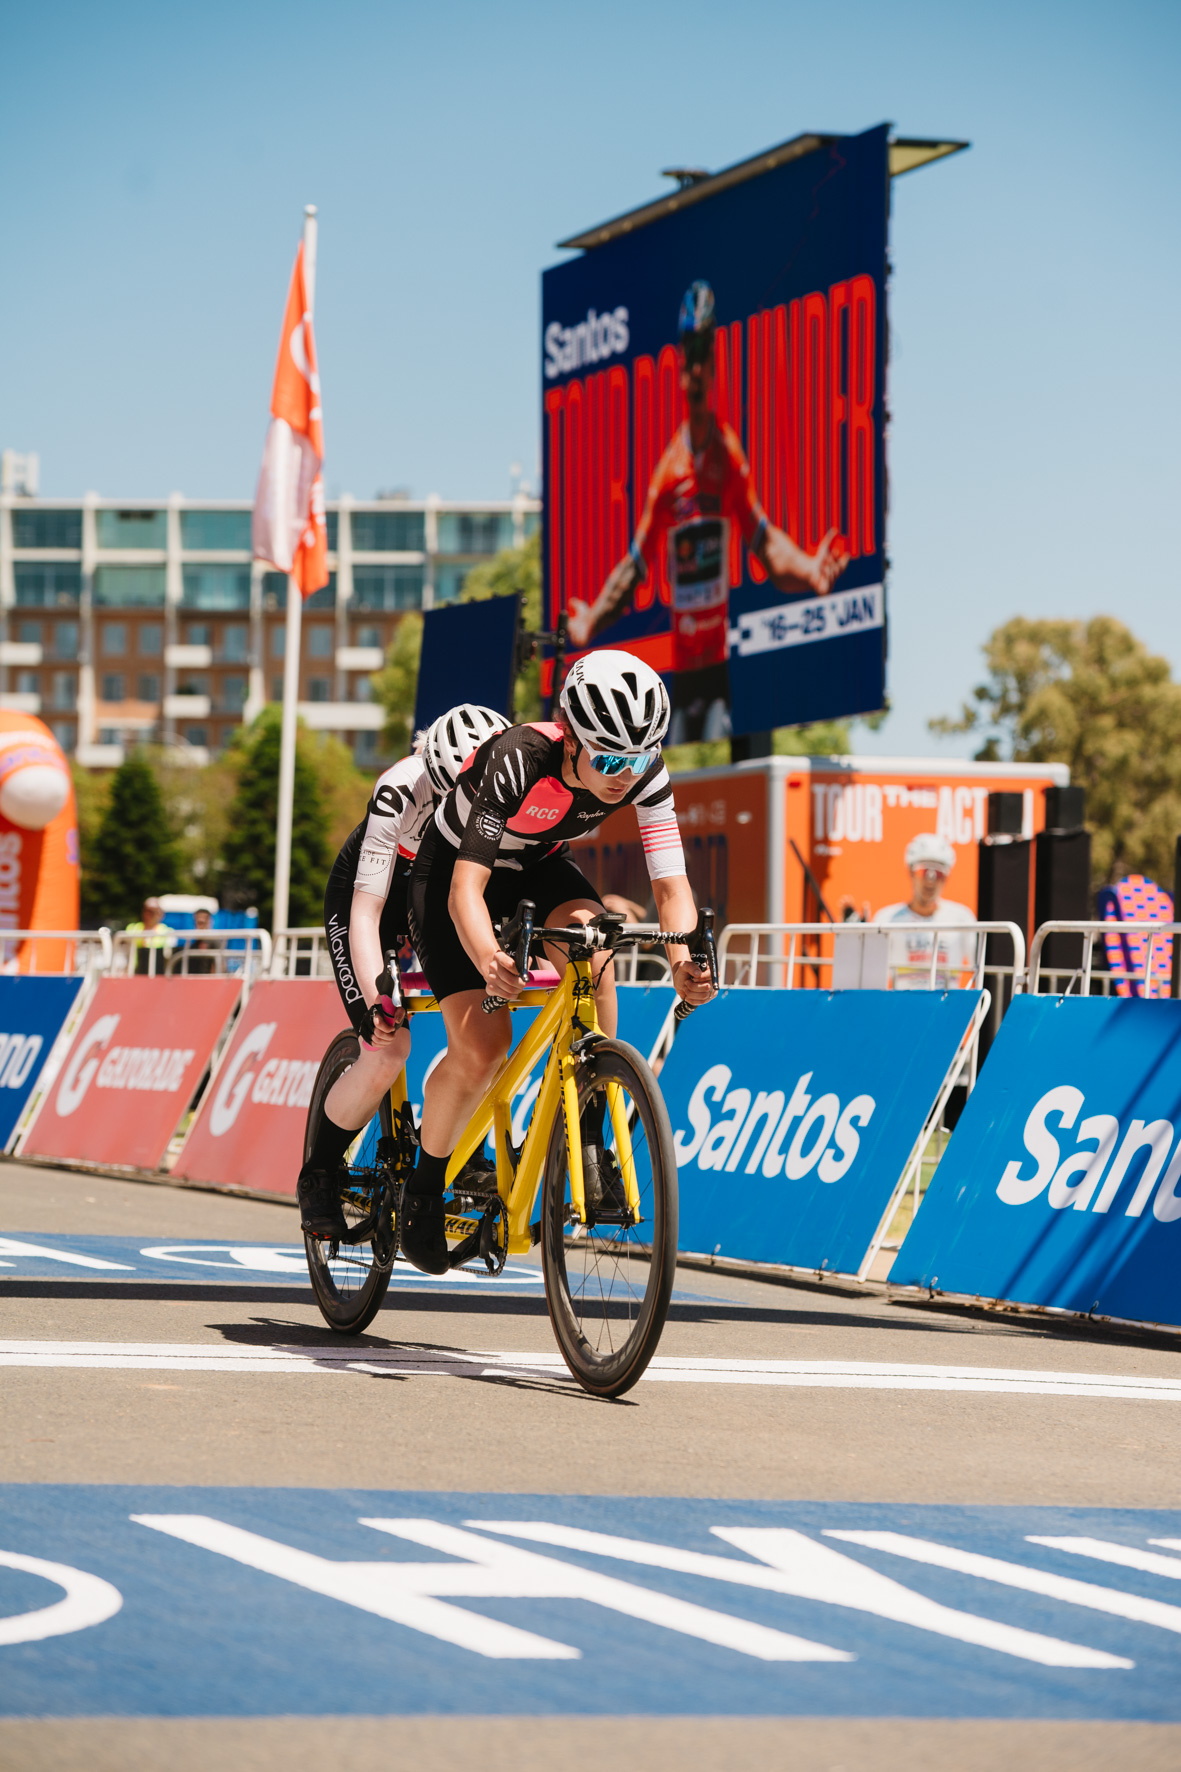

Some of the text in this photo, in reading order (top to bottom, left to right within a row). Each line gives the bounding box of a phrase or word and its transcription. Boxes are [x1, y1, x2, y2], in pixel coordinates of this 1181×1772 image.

[545, 306, 629, 378] Santos
[545, 364, 628, 632] TOUR
[634, 325, 743, 610] DON
[748, 274, 875, 584] UNDER
[526, 805, 559, 820] RCC
[577, 810, 606, 821] Rapha
[813, 783, 883, 842] TOUR
[884, 785, 937, 808] THE
[369, 856, 387, 866] FIT
[328, 913, 364, 1004] villawood
[96, 1046, 195, 1092] GATORADE
[673, 1063, 876, 1184] Santos
